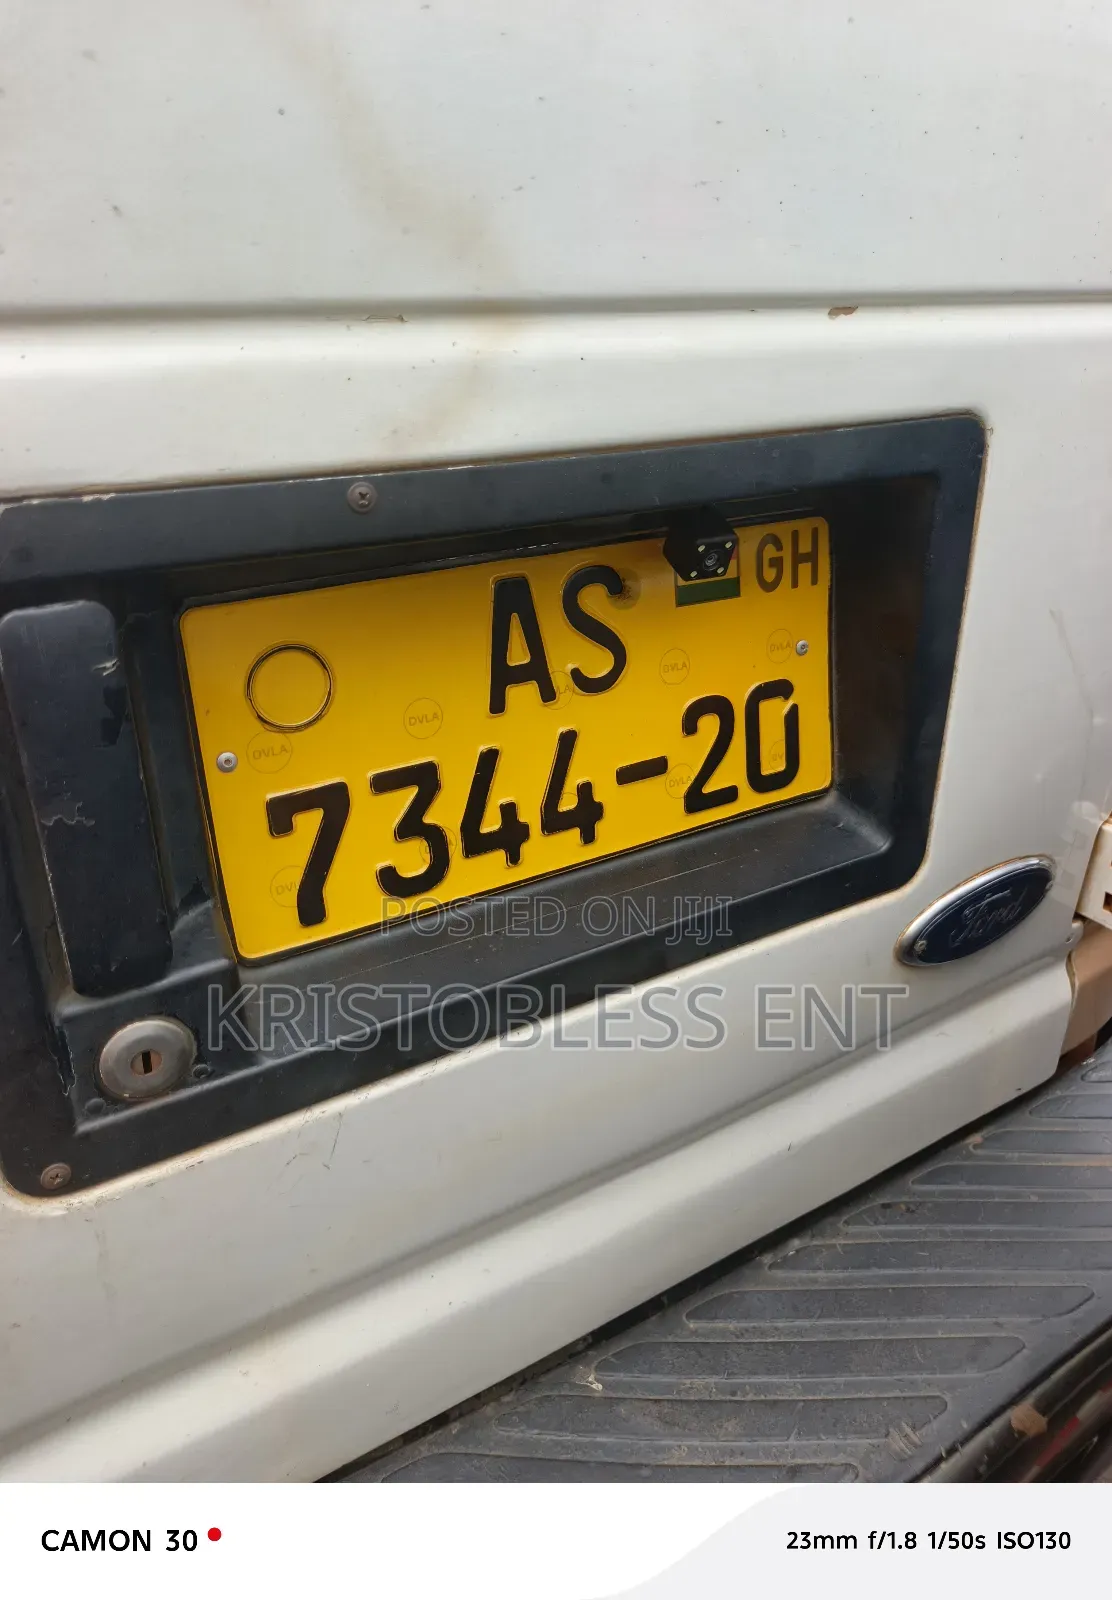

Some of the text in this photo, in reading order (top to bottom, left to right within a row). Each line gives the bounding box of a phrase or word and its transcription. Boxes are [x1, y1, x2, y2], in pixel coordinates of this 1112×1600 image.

[755, 526, 819, 593] GH
[488, 564, 628, 716] AS
[408, 712, 440, 727] DVLA
[252, 745, 289, 761] DVLA
[265, 678, 801, 927] 7344-20
[950, 886, 1028, 947] Ford
